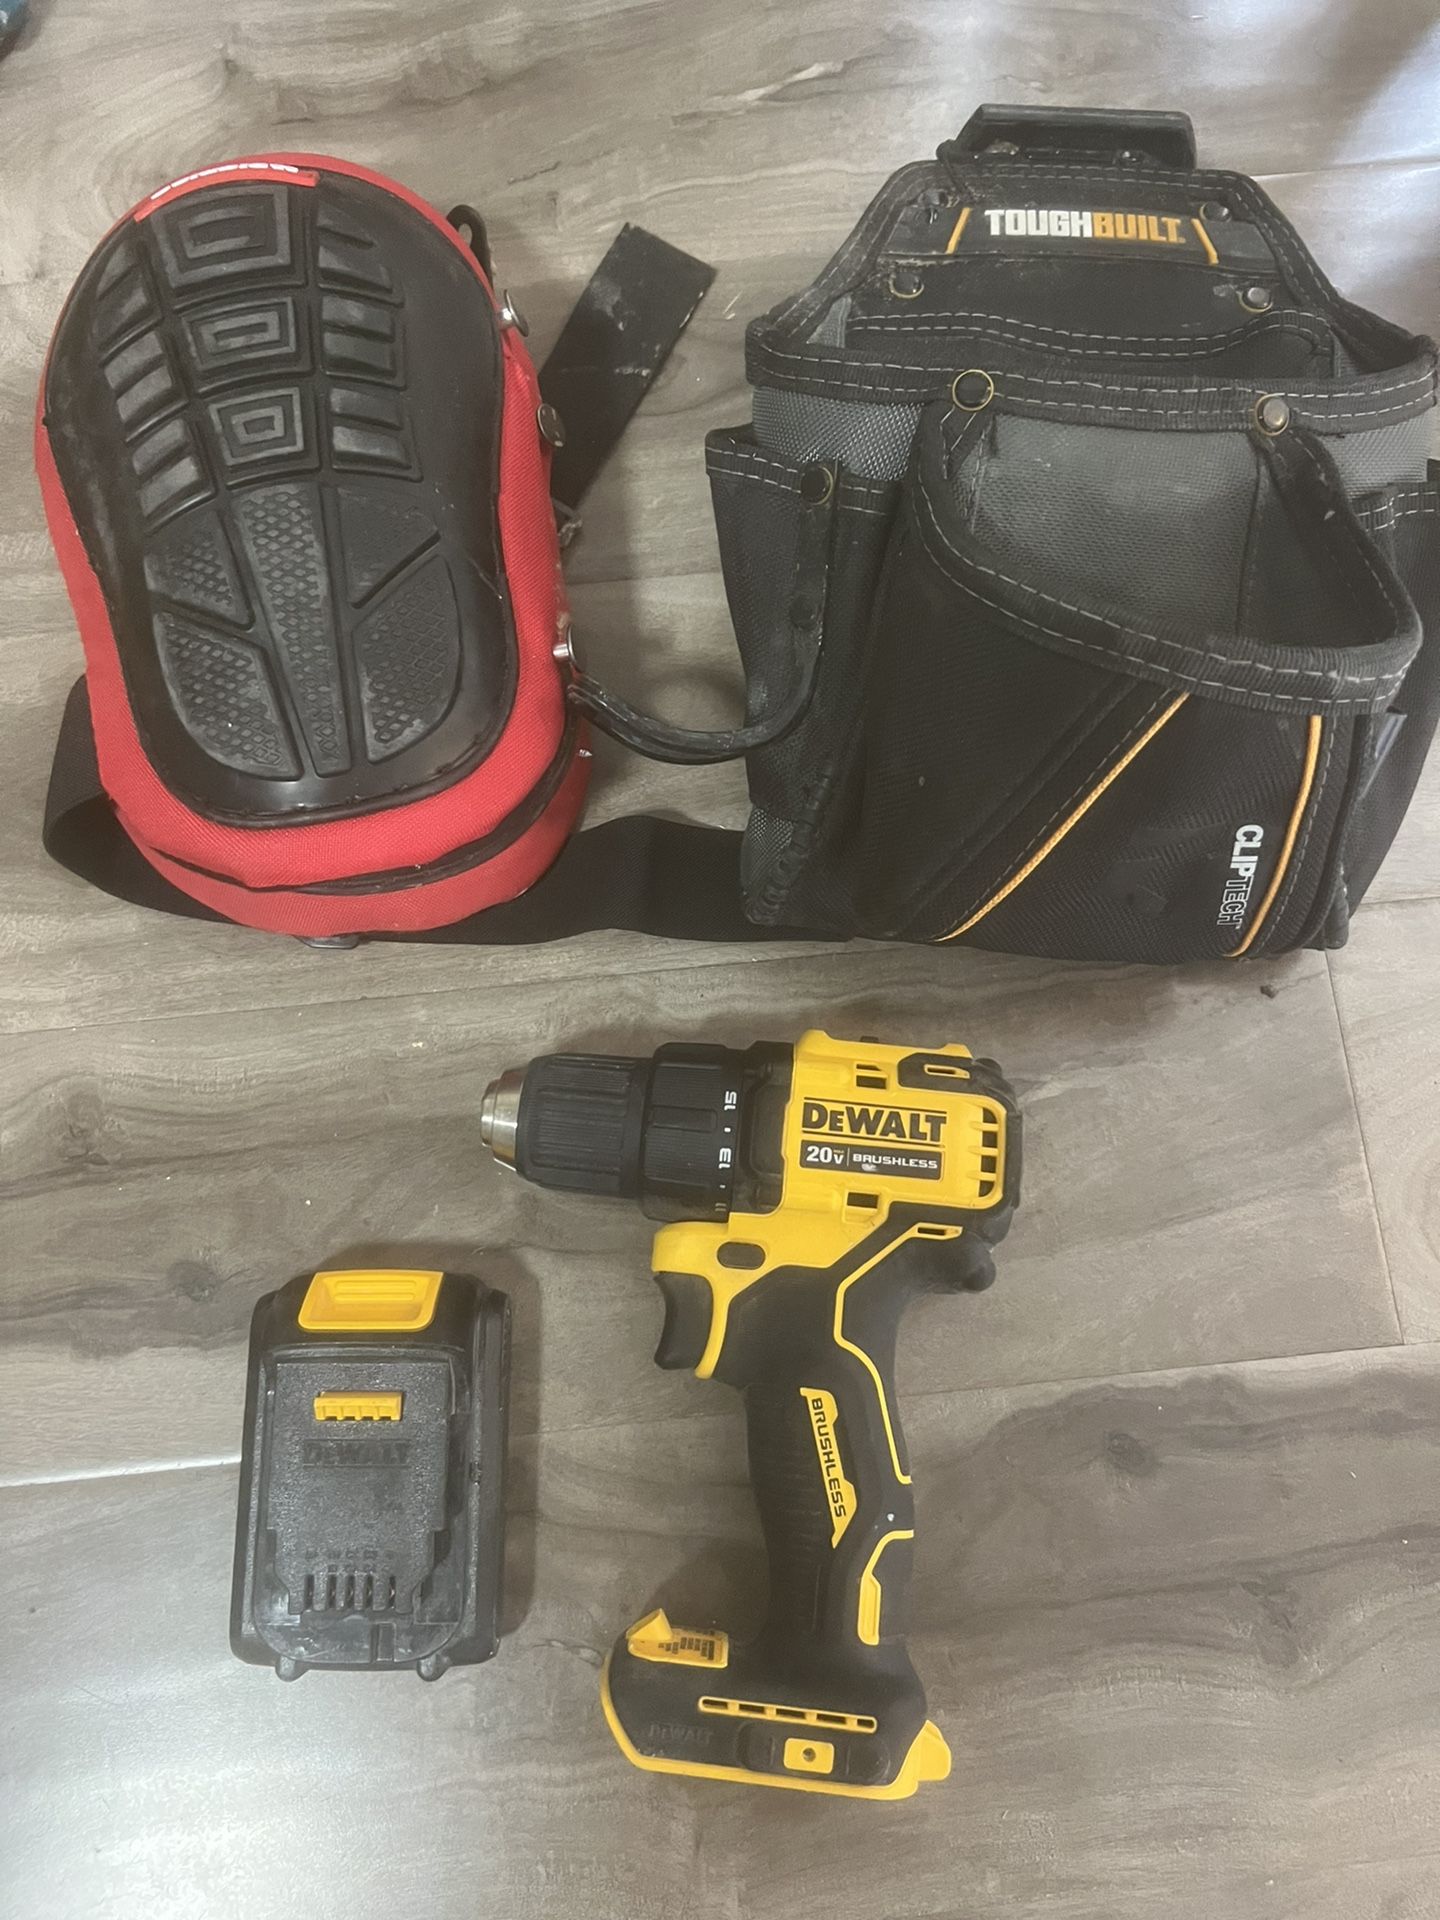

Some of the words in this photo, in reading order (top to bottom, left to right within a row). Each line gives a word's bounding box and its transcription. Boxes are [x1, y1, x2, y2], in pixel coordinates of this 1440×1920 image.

[984, 209, 1182, 243] TOUGHBUILT
[1217, 824, 1264, 926] CLIPTECH
[724, 1091, 738, 1111] 15
[801, 1101, 947, 1143] DEWALT
[718, 1147, 732, 1169] 13
[852, 1153, 938, 1169] BRUSHLESS
[811, 1397, 847, 1518] BRUSHLESS
